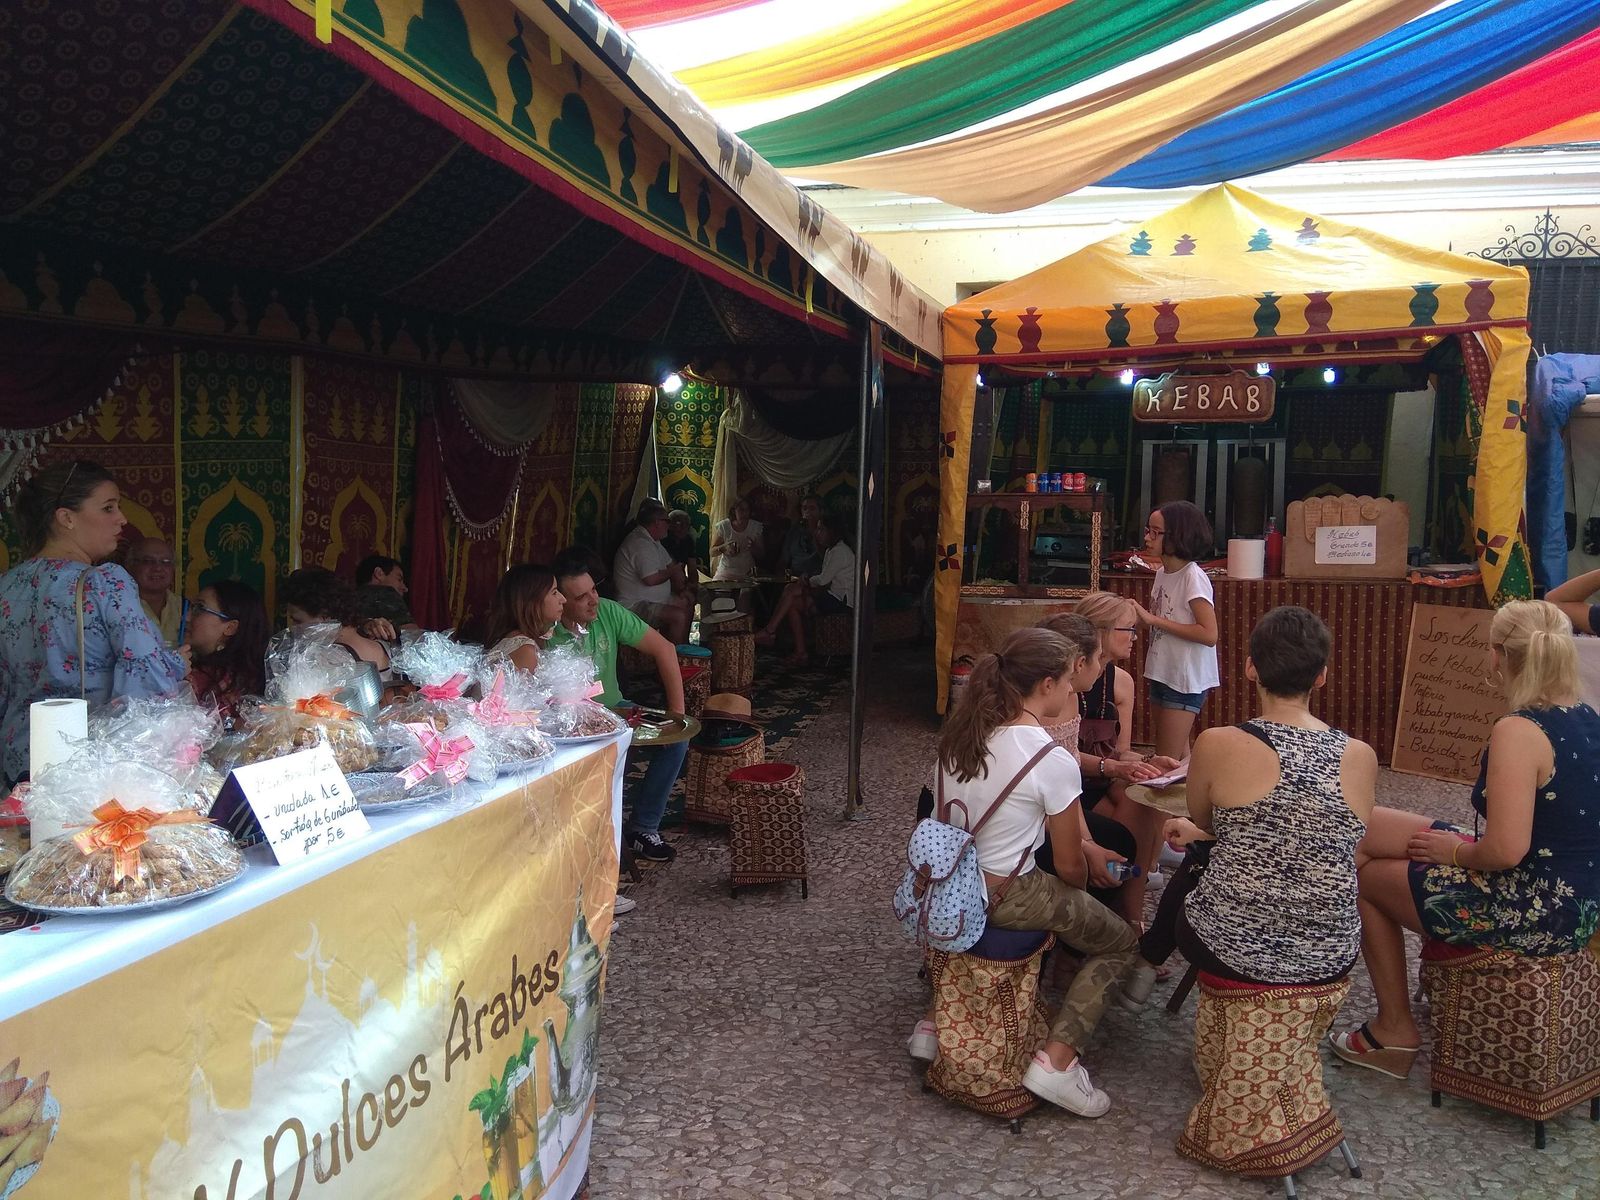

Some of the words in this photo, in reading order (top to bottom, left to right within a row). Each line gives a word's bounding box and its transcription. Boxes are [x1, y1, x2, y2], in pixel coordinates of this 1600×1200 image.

[1146, 384, 1260, 413] KEBAB
[1419, 616, 1449, 645] Los
[1419, 648, 1439, 667] de
[1409, 721, 1437, 735] Kebab
[1421, 757, 1468, 777] Gracias
[304, 832, 322, 856] por
[263, 1053, 431, 1200] Dulces
[444, 949, 560, 1083] Árabes
